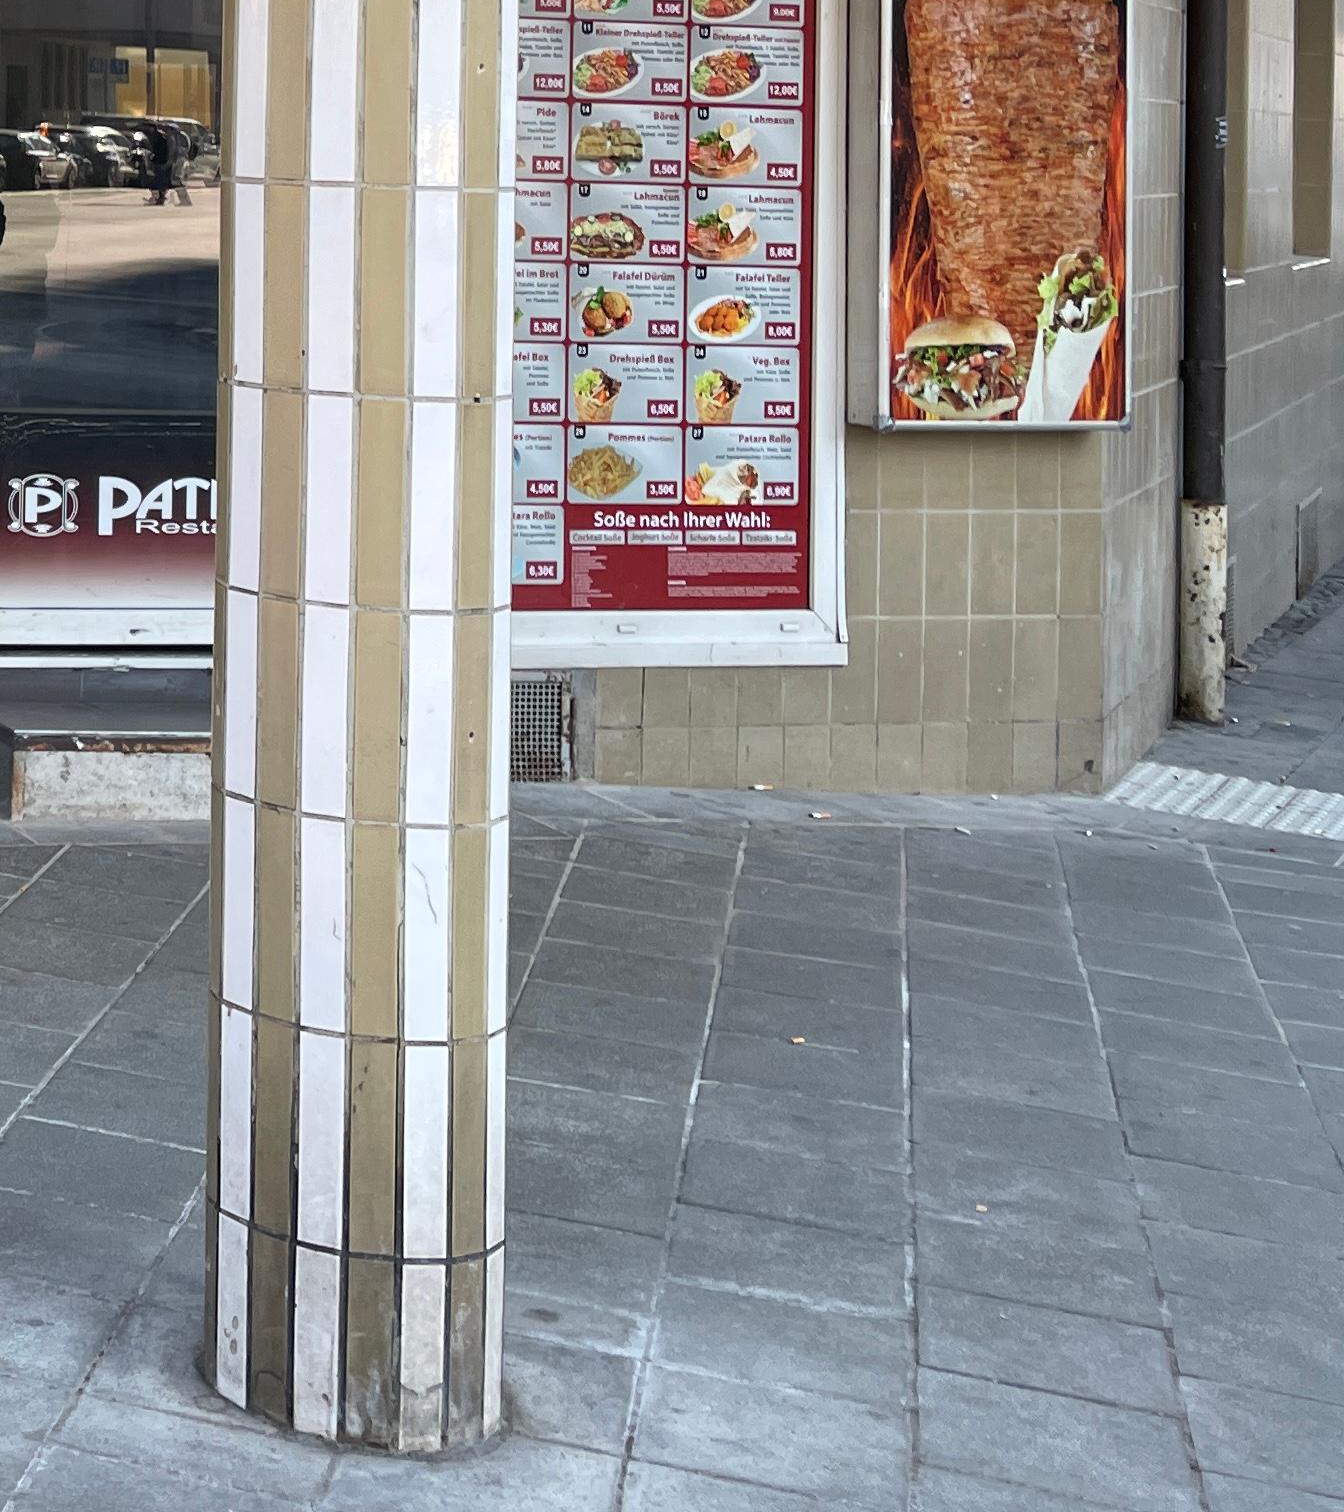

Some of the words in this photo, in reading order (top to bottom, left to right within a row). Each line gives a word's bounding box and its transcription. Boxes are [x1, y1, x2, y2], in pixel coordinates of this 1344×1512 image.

[536, 107, 557, 118] Pide
[653, 110, 680, 122] Börek
[749, 114, 795, 126] Lahmacun
[634, 192, 680, 203] Lahmacun
[749, 194, 794, 205] Lahmacun
[539, 269, 559, 279] Brot
[612, 272, 643, 282] Falafel
[735, 273, 766, 284] Falafel
[766, 274, 792, 284] Teller
[531, 354, 549, 363] Box
[609, 354, 657, 366] Drehspieß
[608, 433, 646, 443] Pommes
[738, 434, 768, 445] Patara
[769, 435, 792, 445] Rollo
[532, 512, 556, 522] Rollo
[593, 510, 636, 528] Soße
[639, 511, 680, 528] nach
[683, 511, 723, 529] Ihrer
[724, 511, 772, 529] Wahl:
